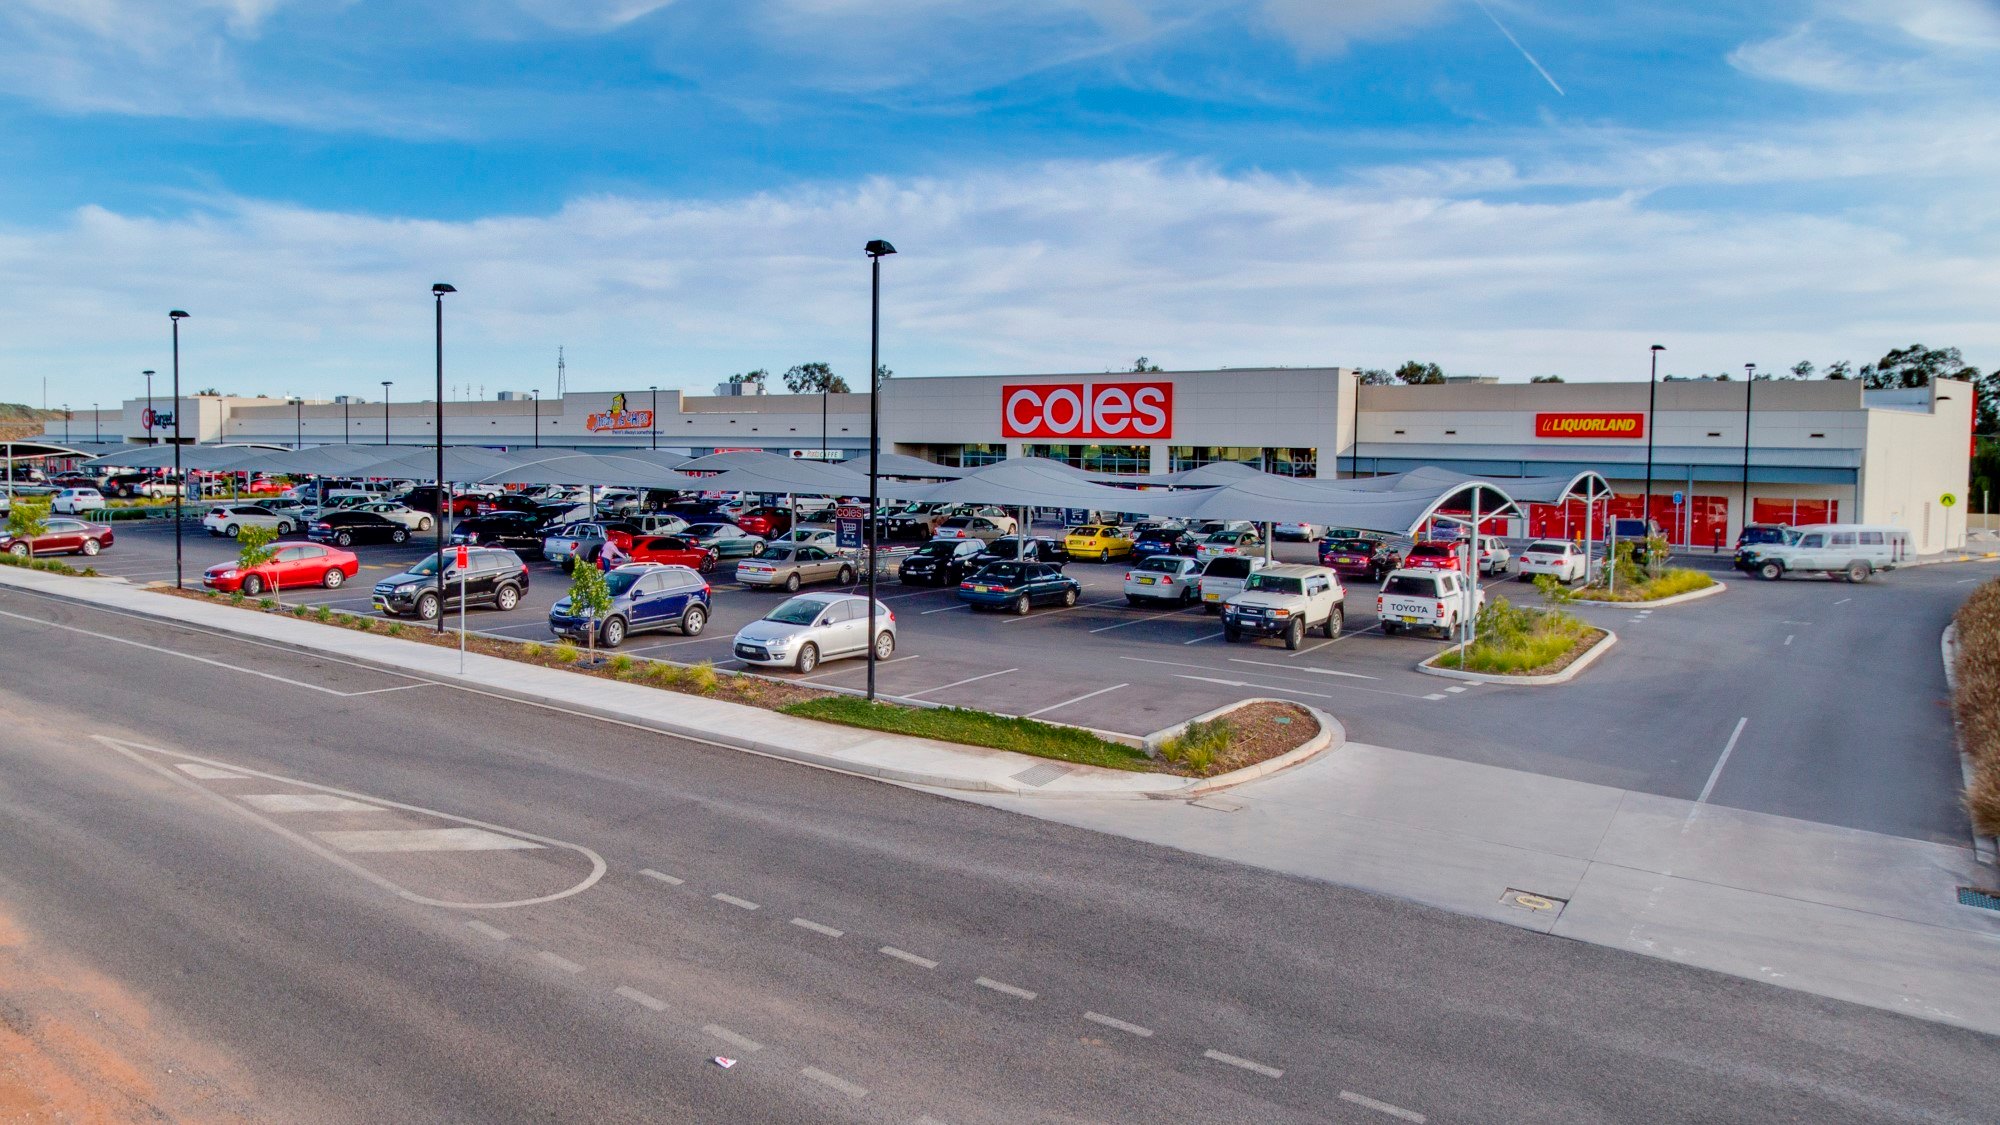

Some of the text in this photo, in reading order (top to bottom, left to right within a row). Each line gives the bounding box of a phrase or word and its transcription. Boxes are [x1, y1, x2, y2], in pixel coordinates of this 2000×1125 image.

[1006, 383, 1166, 434] coles
[1553, 419, 1636, 432] LIQUORLAND
[837, 508, 862, 518] coles
[1391, 603, 1429, 614] TOYOTA
